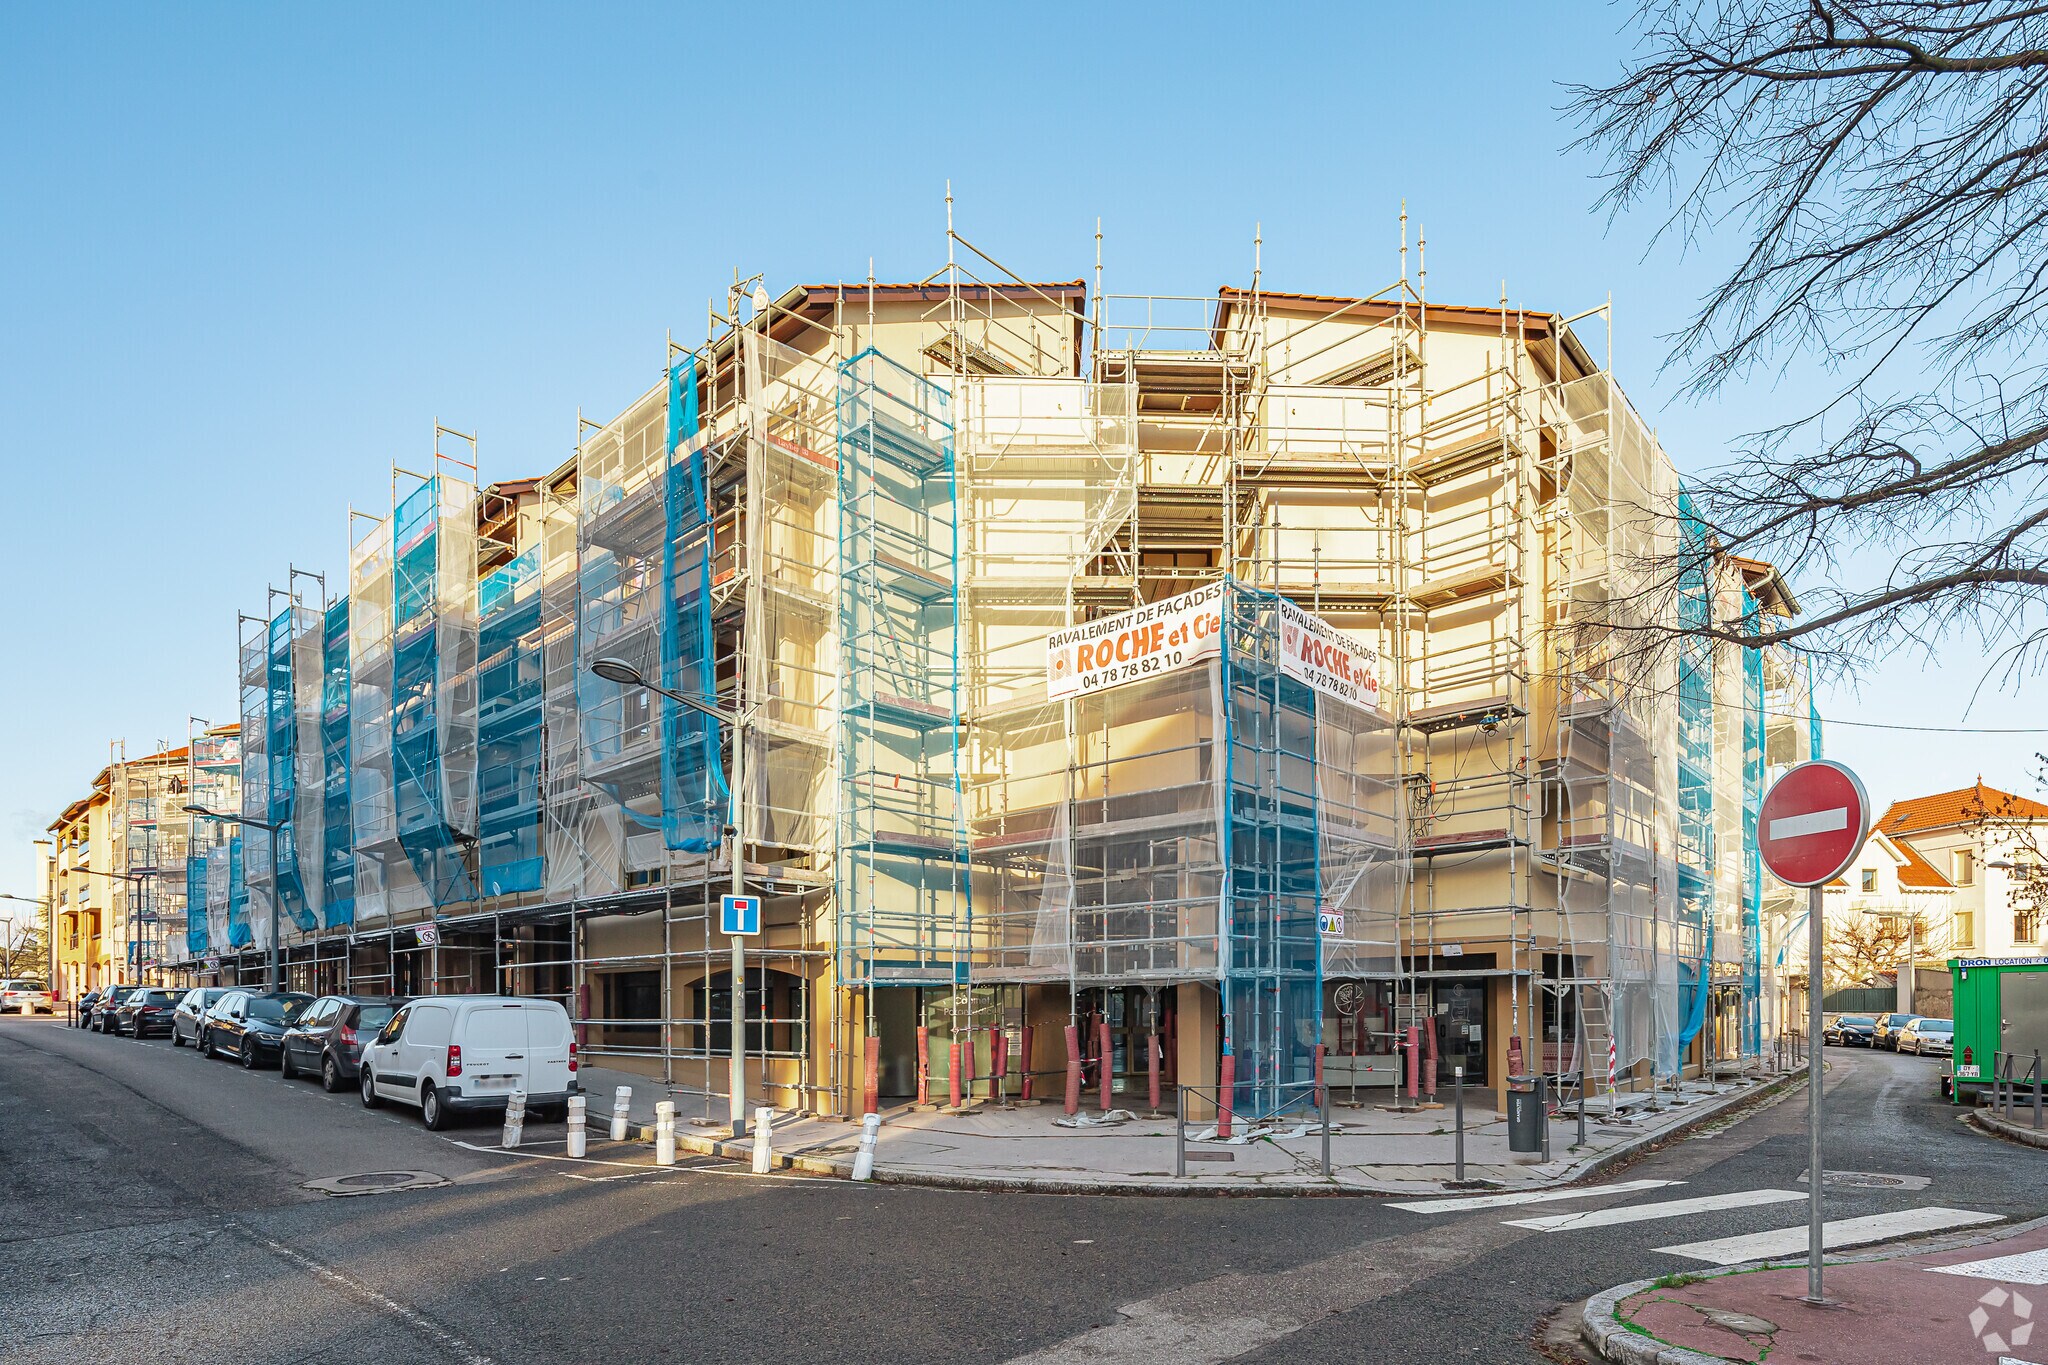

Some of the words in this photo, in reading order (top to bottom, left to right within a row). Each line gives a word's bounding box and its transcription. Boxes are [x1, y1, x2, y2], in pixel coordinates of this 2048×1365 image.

[1048, 614, 1134, 649] RAVALEMENT
[1136, 608, 1154, 625] DE
[1157, 584, 1221, 617] FAÇADES
[1077, 621, 1164, 673] ROCHE
[1168, 622, 1188, 647] et
[1193, 612, 1221, 640] Cie
[1281, 604, 1335, 642] RAVALEMENT
[1335, 633, 1345, 648] DE
[1346, 639, 1377, 663] FAÇADES
[1083, 674, 1098, 688] 04
[1101, 669, 1118, 684] 78
[1121, 663, 1138, 679] 78
[1142, 657, 1160, 673] 82
[1164, 651, 1182, 667] 10
[1300, 632, 1351, 681] ROCHE
[1353, 668, 1363, 686] et
[1363, 669, 1378, 693] Cie
[1303, 667, 1314, 682] 04
[1316, 672, 1327, 687] 78
[1328, 677, 1339, 692] 78
[1339, 682, 1349, 697] 82
[1349, 687, 1357, 701] 10
[1994, 957, 2032, 965] LOCATION
